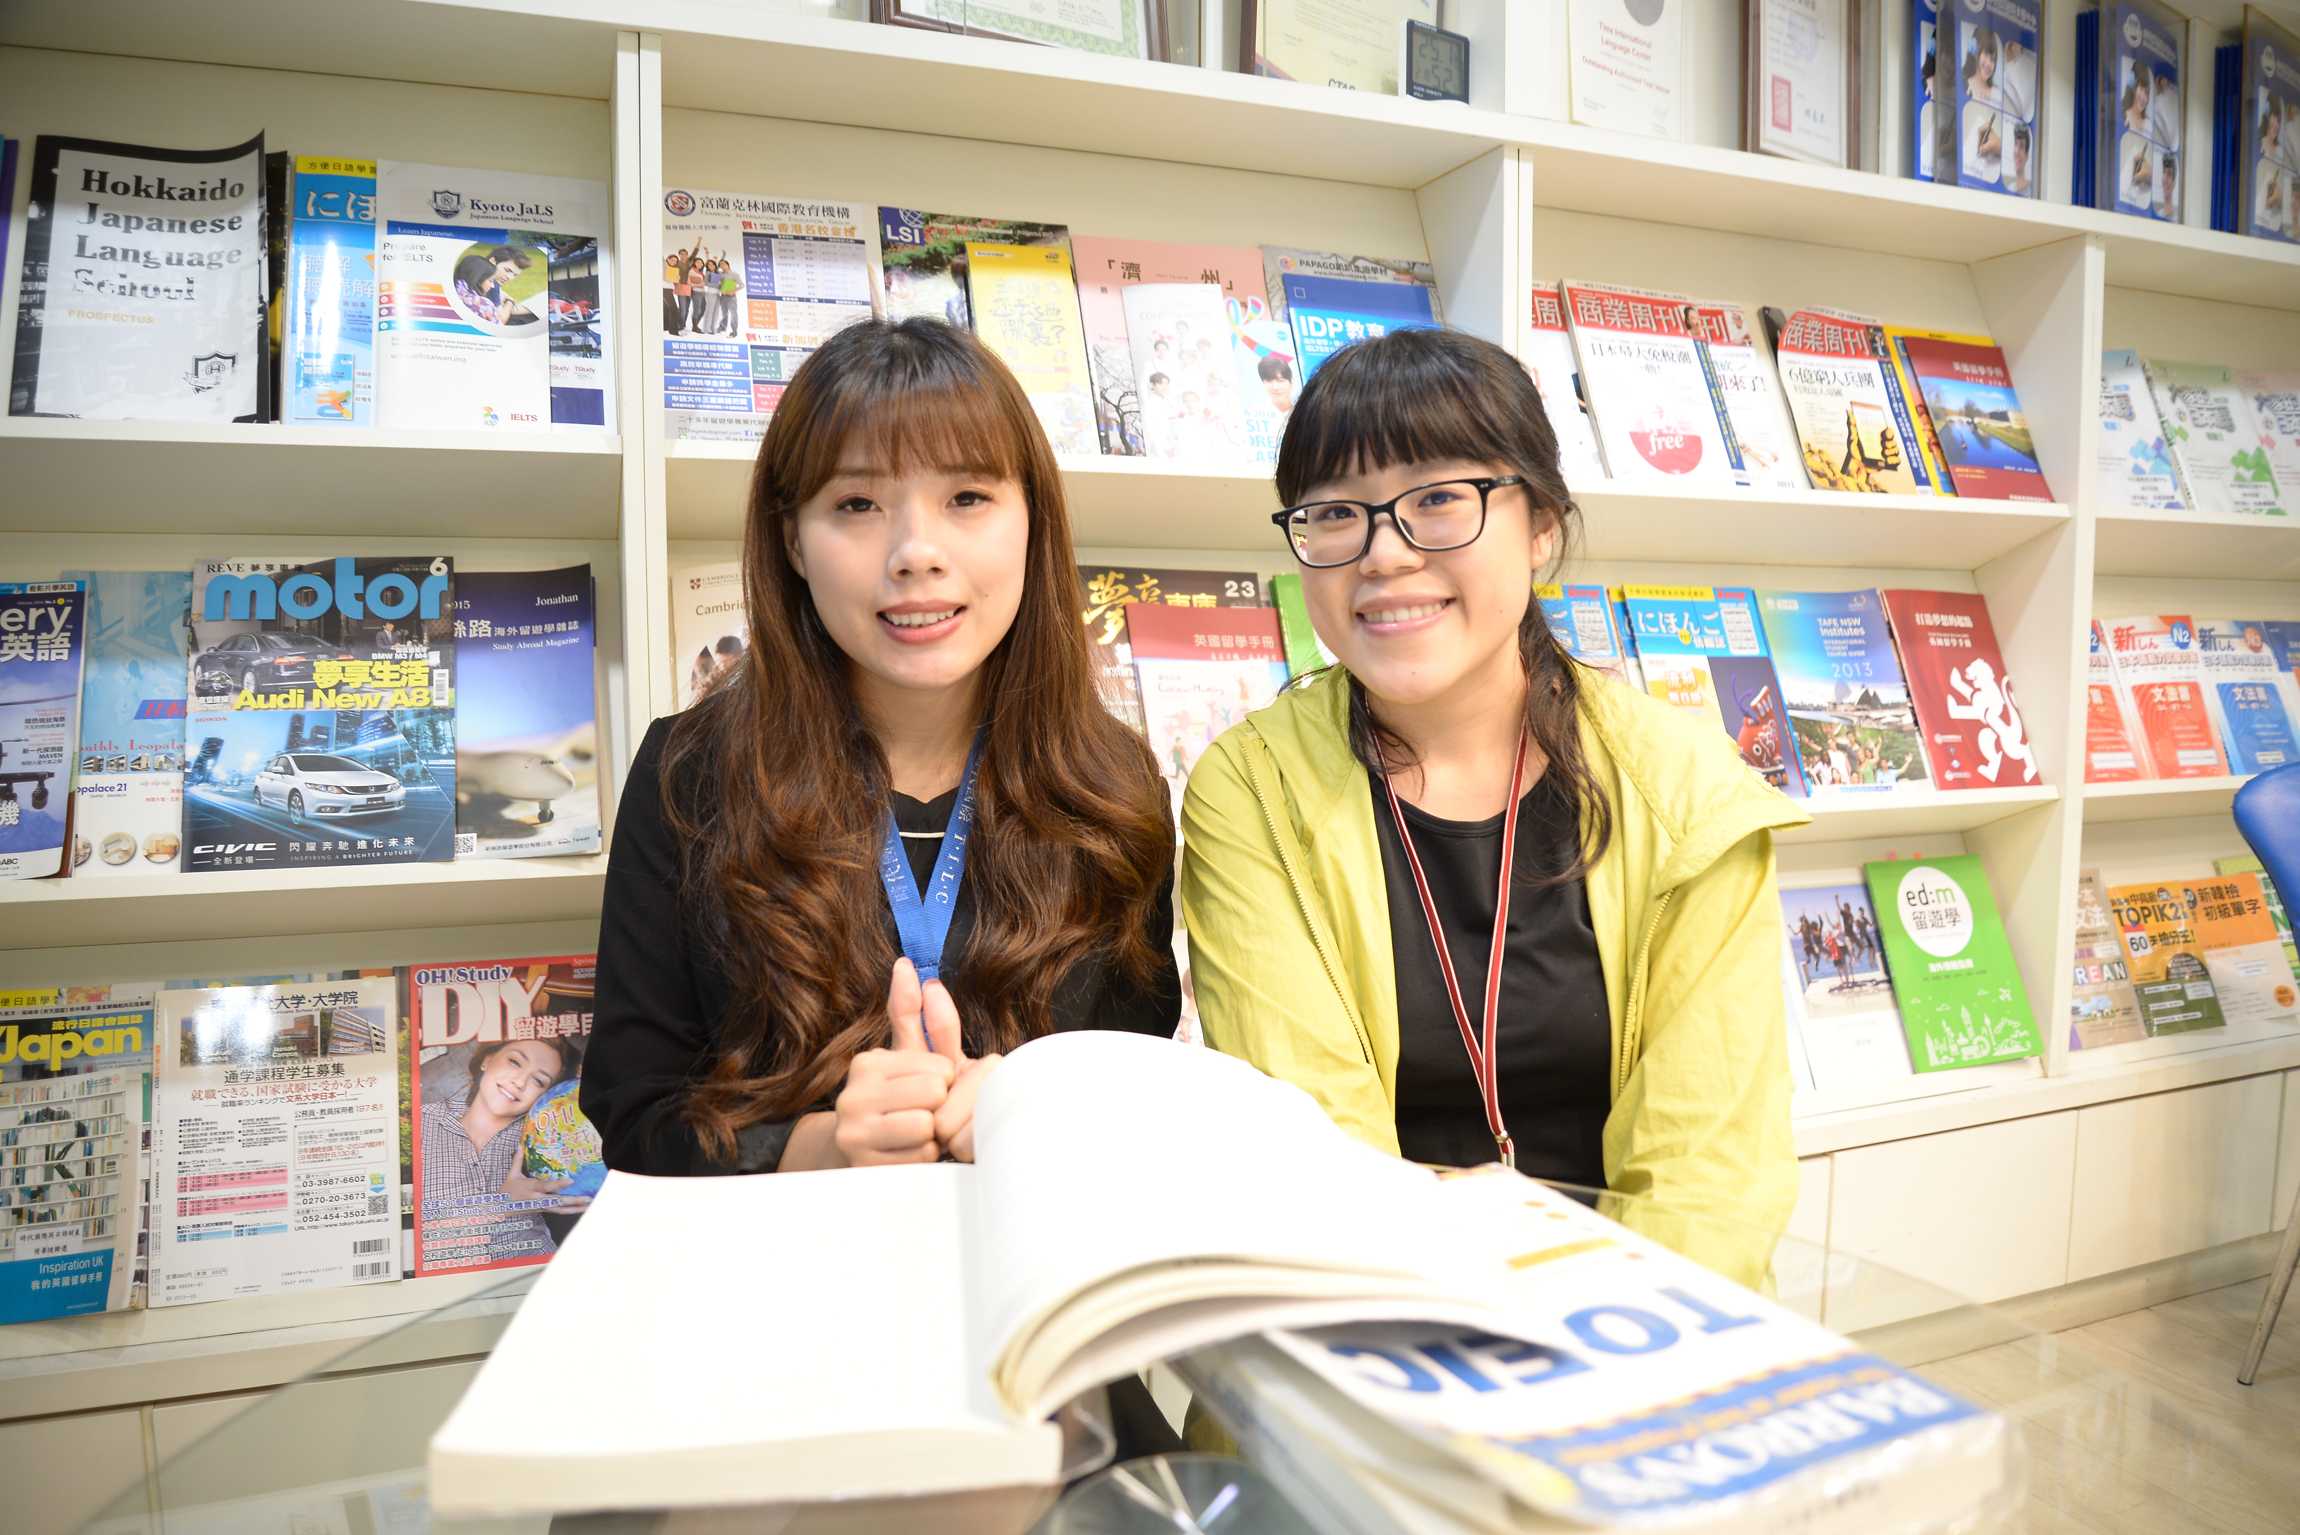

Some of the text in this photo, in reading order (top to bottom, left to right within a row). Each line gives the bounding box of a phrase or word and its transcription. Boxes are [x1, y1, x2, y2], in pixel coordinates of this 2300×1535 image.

[81, 168, 244, 202] Hokkaido
[470, 199, 554, 218] Kyoto JaLS
[700, 198, 850, 219] 富蘭克林國際教育機構
[76, 202, 242, 234] Japanese
[470, 213, 554, 225] Japanese Language School
[886, 225, 920, 244] LSI
[74, 235, 241, 270] Language
[1576, 291, 1688, 335] 商業周刊
[1784, 317, 1870, 356] 商業周刊
[510, 412, 538, 422] IELTS
[1649, 432, 1684, 454] free
[206, 562, 245, 574] REVE
[204, 557, 449, 620] motor 6
[1225, 580, 1256, 598] 23
[535, 593, 579, 608] Jonathan
[695, 600, 745, 617] Cambri
[0, 605, 72, 639] ery
[494, 620, 579, 637] 海外留遊學雜誌
[1817, 616, 1861, 627] TAFE NSW
[1819, 627, 1866, 637] Institutes
[2172, 627, 2191, 644] N2
[1, 633, 71, 662] 英語
[492, 635, 580, 651] Study Abroad Magazine
[1194, 634, 1274, 649] 英國留學手冊
[371, 652, 393, 660] BMW
[313, 660, 429, 689] 夢享生活
[1832, 662, 1873, 679] 2013
[233, 688, 431, 710] Audi New A8
[76, 783, 127, 796] opalace 21
[0, 801, 20, 826] 機
[192, 841, 277, 854] CIVIC
[289, 837, 416, 853] 閃耀奔馳 進化未來
[213, 855, 254, 866] 全新登場
[342, 851, 381, 861] BRIGHTER
[383, 849, 413, 857] FUTURE
[1906, 883, 1957, 907] ed:m
[2198, 884, 2241, 902] 新韓檢
[2203, 898, 2262, 922] 初級單字
[2129, 935, 2149, 952] 60
[2074, 961, 2128, 986] REAN
[422, 975, 546, 1047] DIY
[224, 1062, 345, 1085] 通学課程学生募集
[302, 1210, 366, 1224] 052-454-3502
[40, 1256, 104, 1275] Inspiration UK
[1328, 1286, 1765, 1396] TOEIC
